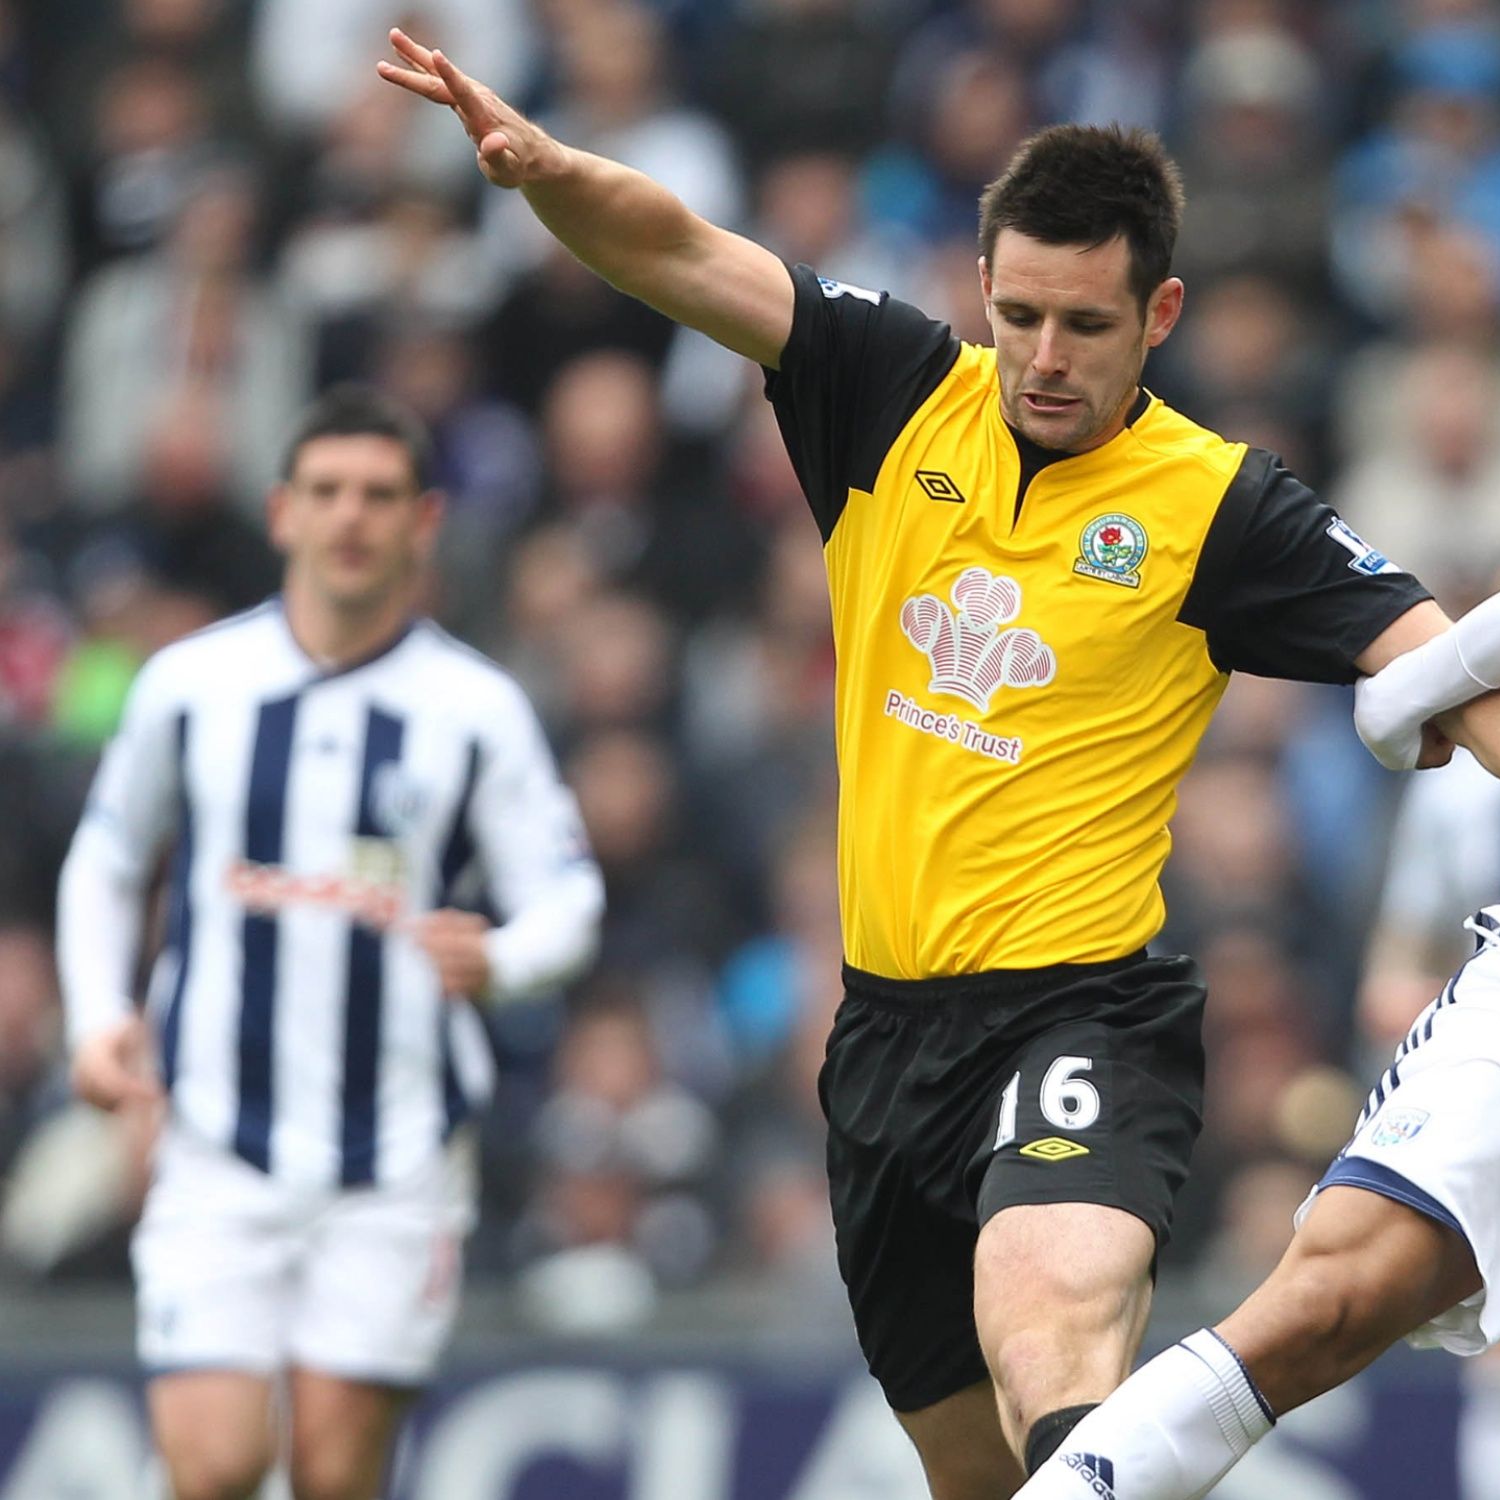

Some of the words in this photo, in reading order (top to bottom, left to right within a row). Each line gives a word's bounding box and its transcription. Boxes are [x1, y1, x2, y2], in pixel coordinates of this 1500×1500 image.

[885, 692, 960, 740] Prince's
[963, 722, 1019, 761] Trust
[993, 1053, 1101, 1152] 16
